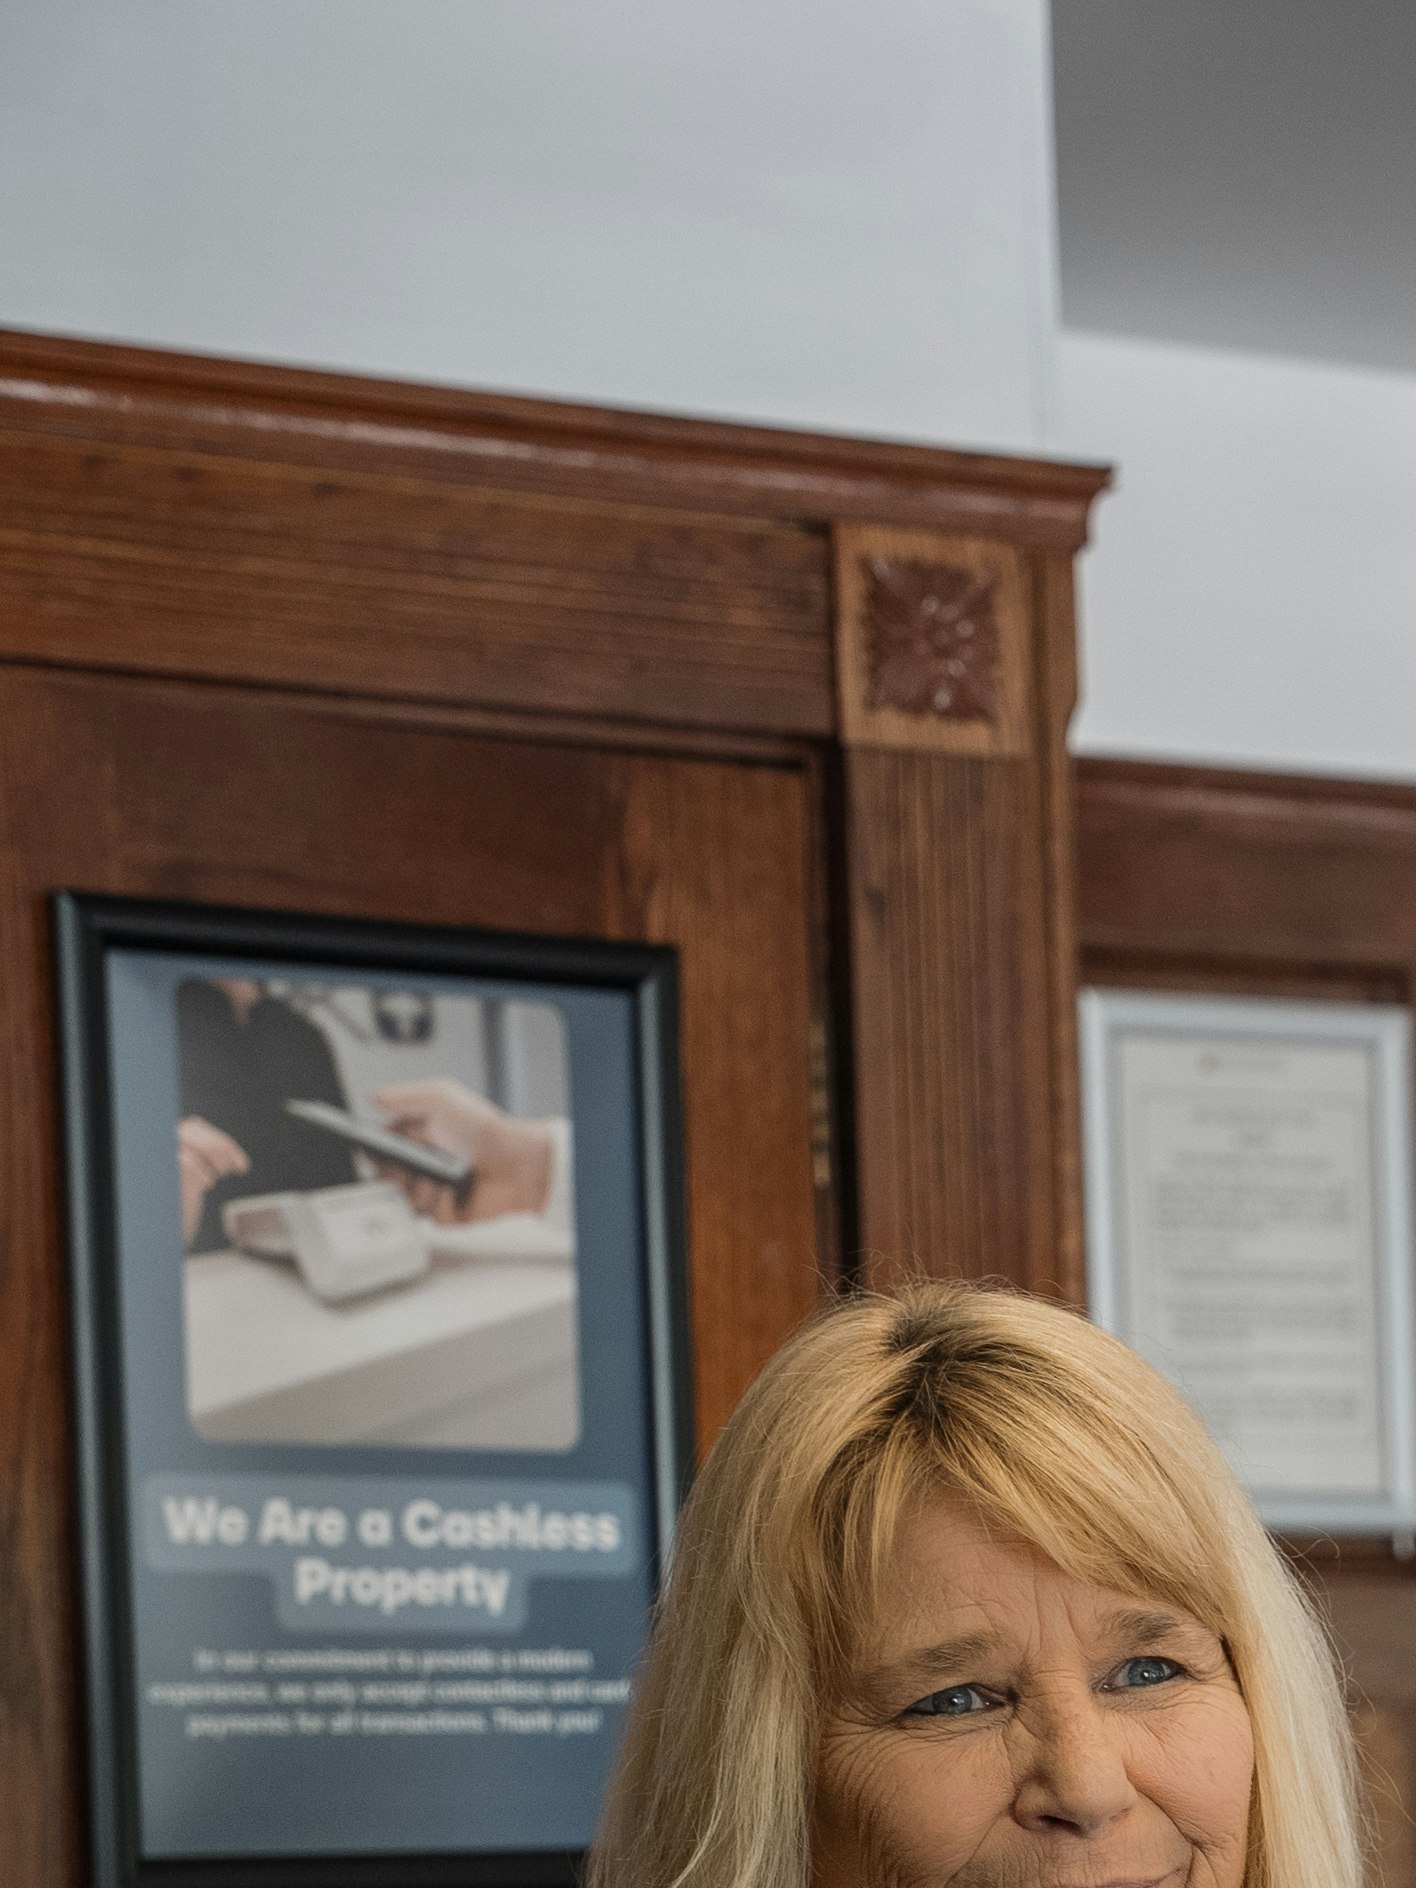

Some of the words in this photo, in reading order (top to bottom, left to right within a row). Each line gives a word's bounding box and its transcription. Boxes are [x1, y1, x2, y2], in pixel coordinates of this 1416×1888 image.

[163, 1497, 249, 1546] We
[258, 1497, 349, 1548] Are
[358, 1508, 394, 1549] a
[404, 1499, 622, 1552] Cashless
[295, 1557, 510, 1617] Property
